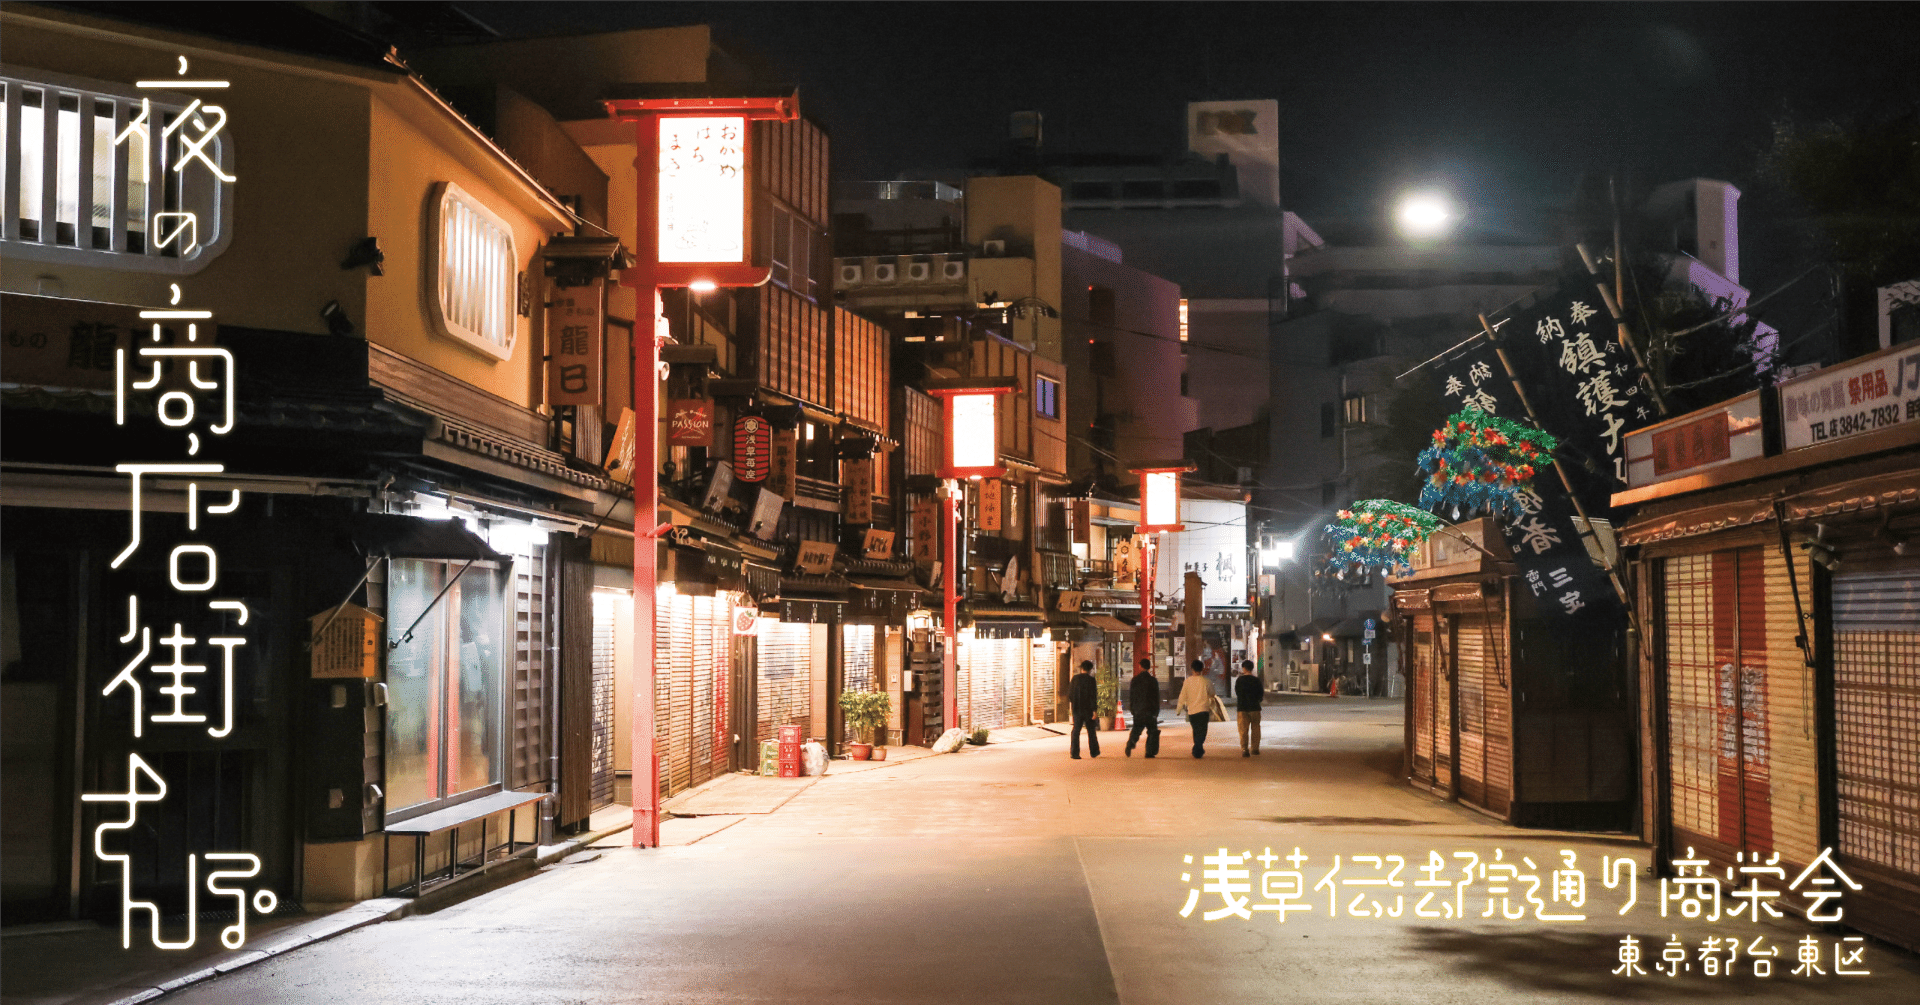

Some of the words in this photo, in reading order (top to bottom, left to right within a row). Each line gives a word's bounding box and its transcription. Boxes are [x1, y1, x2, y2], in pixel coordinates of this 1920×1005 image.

[1604, 340, 1650, 421] 令和四年
[1848, 368, 1889, 405] 祭用品
[672, 419, 709, 430] PASSION
[1810, 421, 1828, 442] TEL
